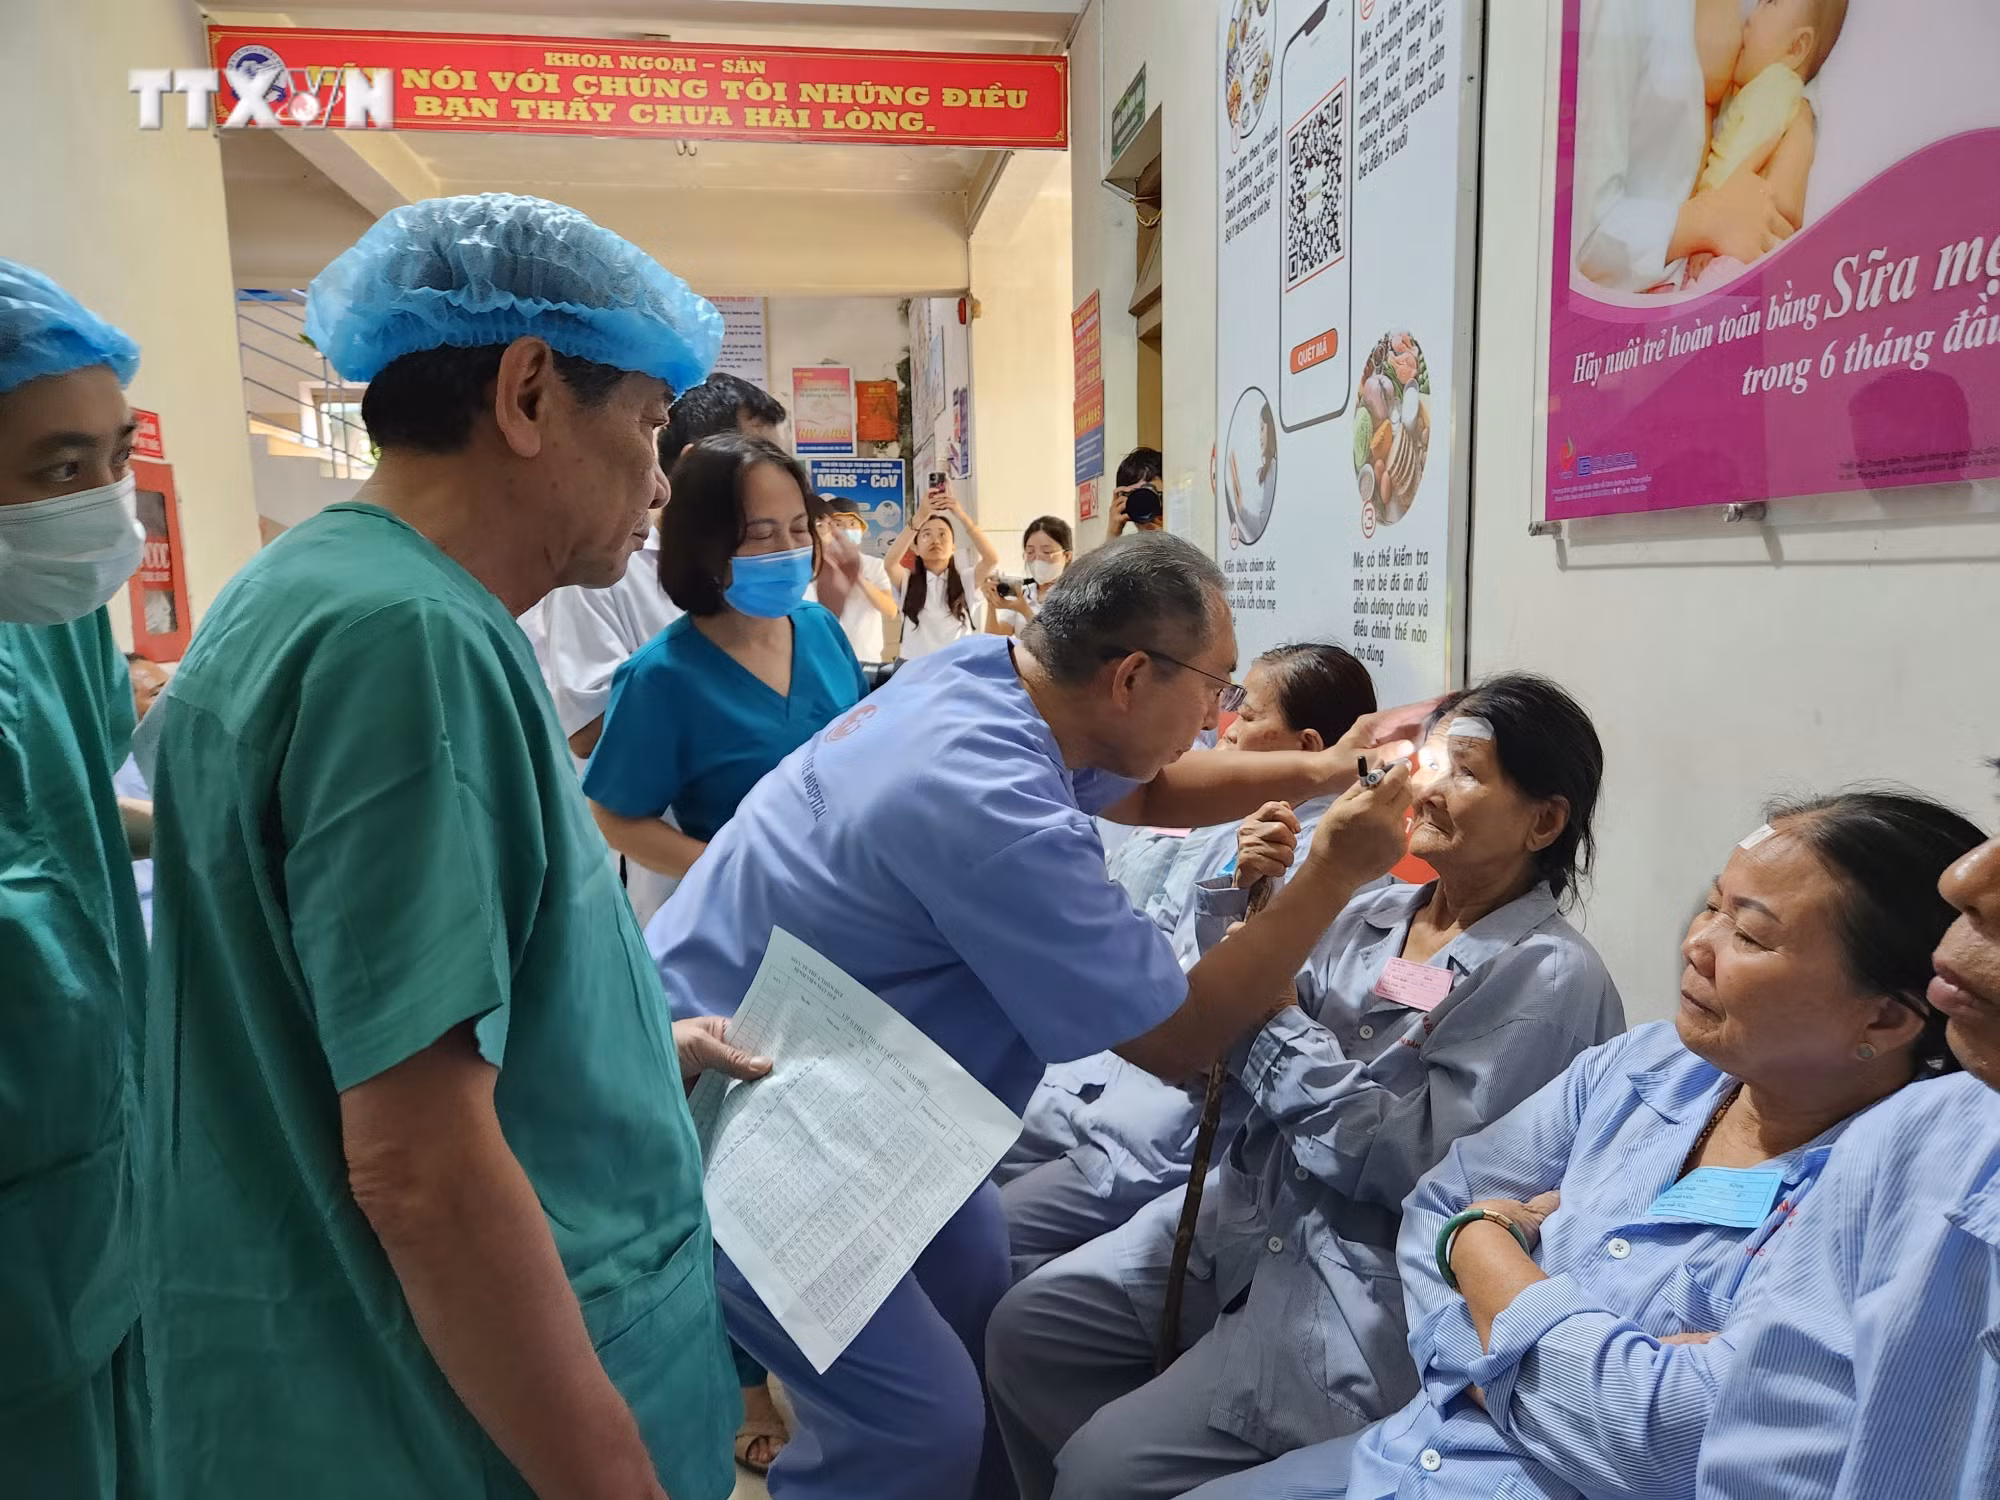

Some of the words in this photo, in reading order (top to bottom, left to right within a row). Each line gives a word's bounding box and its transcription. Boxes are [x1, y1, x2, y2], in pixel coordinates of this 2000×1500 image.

[1360, 30, 1371, 55] Mẹ
[1376, 12, 1384, 38] có
[1381, 26, 1402, 61] trạng
[1406, 4, 1426, 35] tăng
[544, 52, 612, 68] KHOA
[619, 55, 697, 75] NGOẠI
[722, 55, 767, 74] SẢN
[1360, 76, 1378, 107] nặng
[1386, 55, 1400, 81] của
[1407, 37, 1421, 62] mẹ
[1429, 9, 1444, 41] khi
[401, 66, 478, 91] NÓI
[488, 67, 561, 94] VỚI
[572, 74, 709, 99] CHÚNG
[720, 76, 788, 101] TÔI
[798, 80, 931, 106] NHỮNG
[942, 82, 1029, 109] ĐIỀU
[1359, 101, 1380, 130] mang
[1405, 61, 1424, 92] tăng
[1428, 44, 1444, 70] cân
[413, 96, 498, 121] BẠN
[511, 96, 617, 122] THẤY
[628, 104, 733, 126] CHƯA
[744, 104, 811, 129] HÀI
[822, 107, 936, 132] LÒNG.
[1360, 128, 1378, 157] nặng
[1380, 119, 1385, 138] &
[1387, 98, 1409, 133] chiều
[1411, 89, 1426, 113] cao
[1428, 71, 1444, 99] của
[1359, 156, 1368, 181] bé
[1369, 145, 1383, 172] đến
[1385, 140, 1390, 161] 5
[1392, 124, 1408, 156] tuổi
[1823, 246, 1920, 320] Sữa
[1932, 236, 2000, 296] mẹ
[1297, 343, 1315, 367] QUÉT
[1315, 336, 1328, 358] MÃ
[1572, 352, 1602, 387] Hãy
[1605, 338, 1641, 374] nuôi
[1642, 328, 1665, 365] trẻ
[1668, 318, 1713, 357] hoàn
[1718, 304, 1761, 345] toàn
[1766, 280, 1822, 331] bằng
[1741, 358, 1812, 396] trong
[1819, 339, 1839, 379] 6
[1843, 327, 1936, 371] tháng
[816, 474, 858, 488] MERS
[870, 474, 899, 488] CoV
[1364, 507, 1374, 530] 3
[1353, 551, 1364, 573] Mẹ
[1366, 549, 1375, 568] có
[1378, 545, 1391, 568] thể
[1393, 544, 1412, 567] kiểm
[1416, 548, 1428, 566] tra
[1353, 578, 1364, 596] mẹ
[1366, 573, 1375, 591] và
[1378, 573, 1387, 591] bé
[1390, 572, 1400, 591] đã
[1403, 573, 1413, 591] ăn
[1416, 571, 1428, 591] đủ
[1353, 597, 1369, 614] dinh
[1370, 597, 1394, 620] dưỡng
[1396, 597, 1415, 616] chưa
[1418, 598, 1428, 617] và
[1353, 618, 1368, 637] điều
[1371, 620, 1391, 639] chỉnh
[1394, 620, 1409, 640] thế
[1411, 624, 1428, 643] nào
[1353, 641, 1365, 660] cho
[1366, 643, 1385, 667] đúng
[803, 770, 828, 823] HOSPITAL
